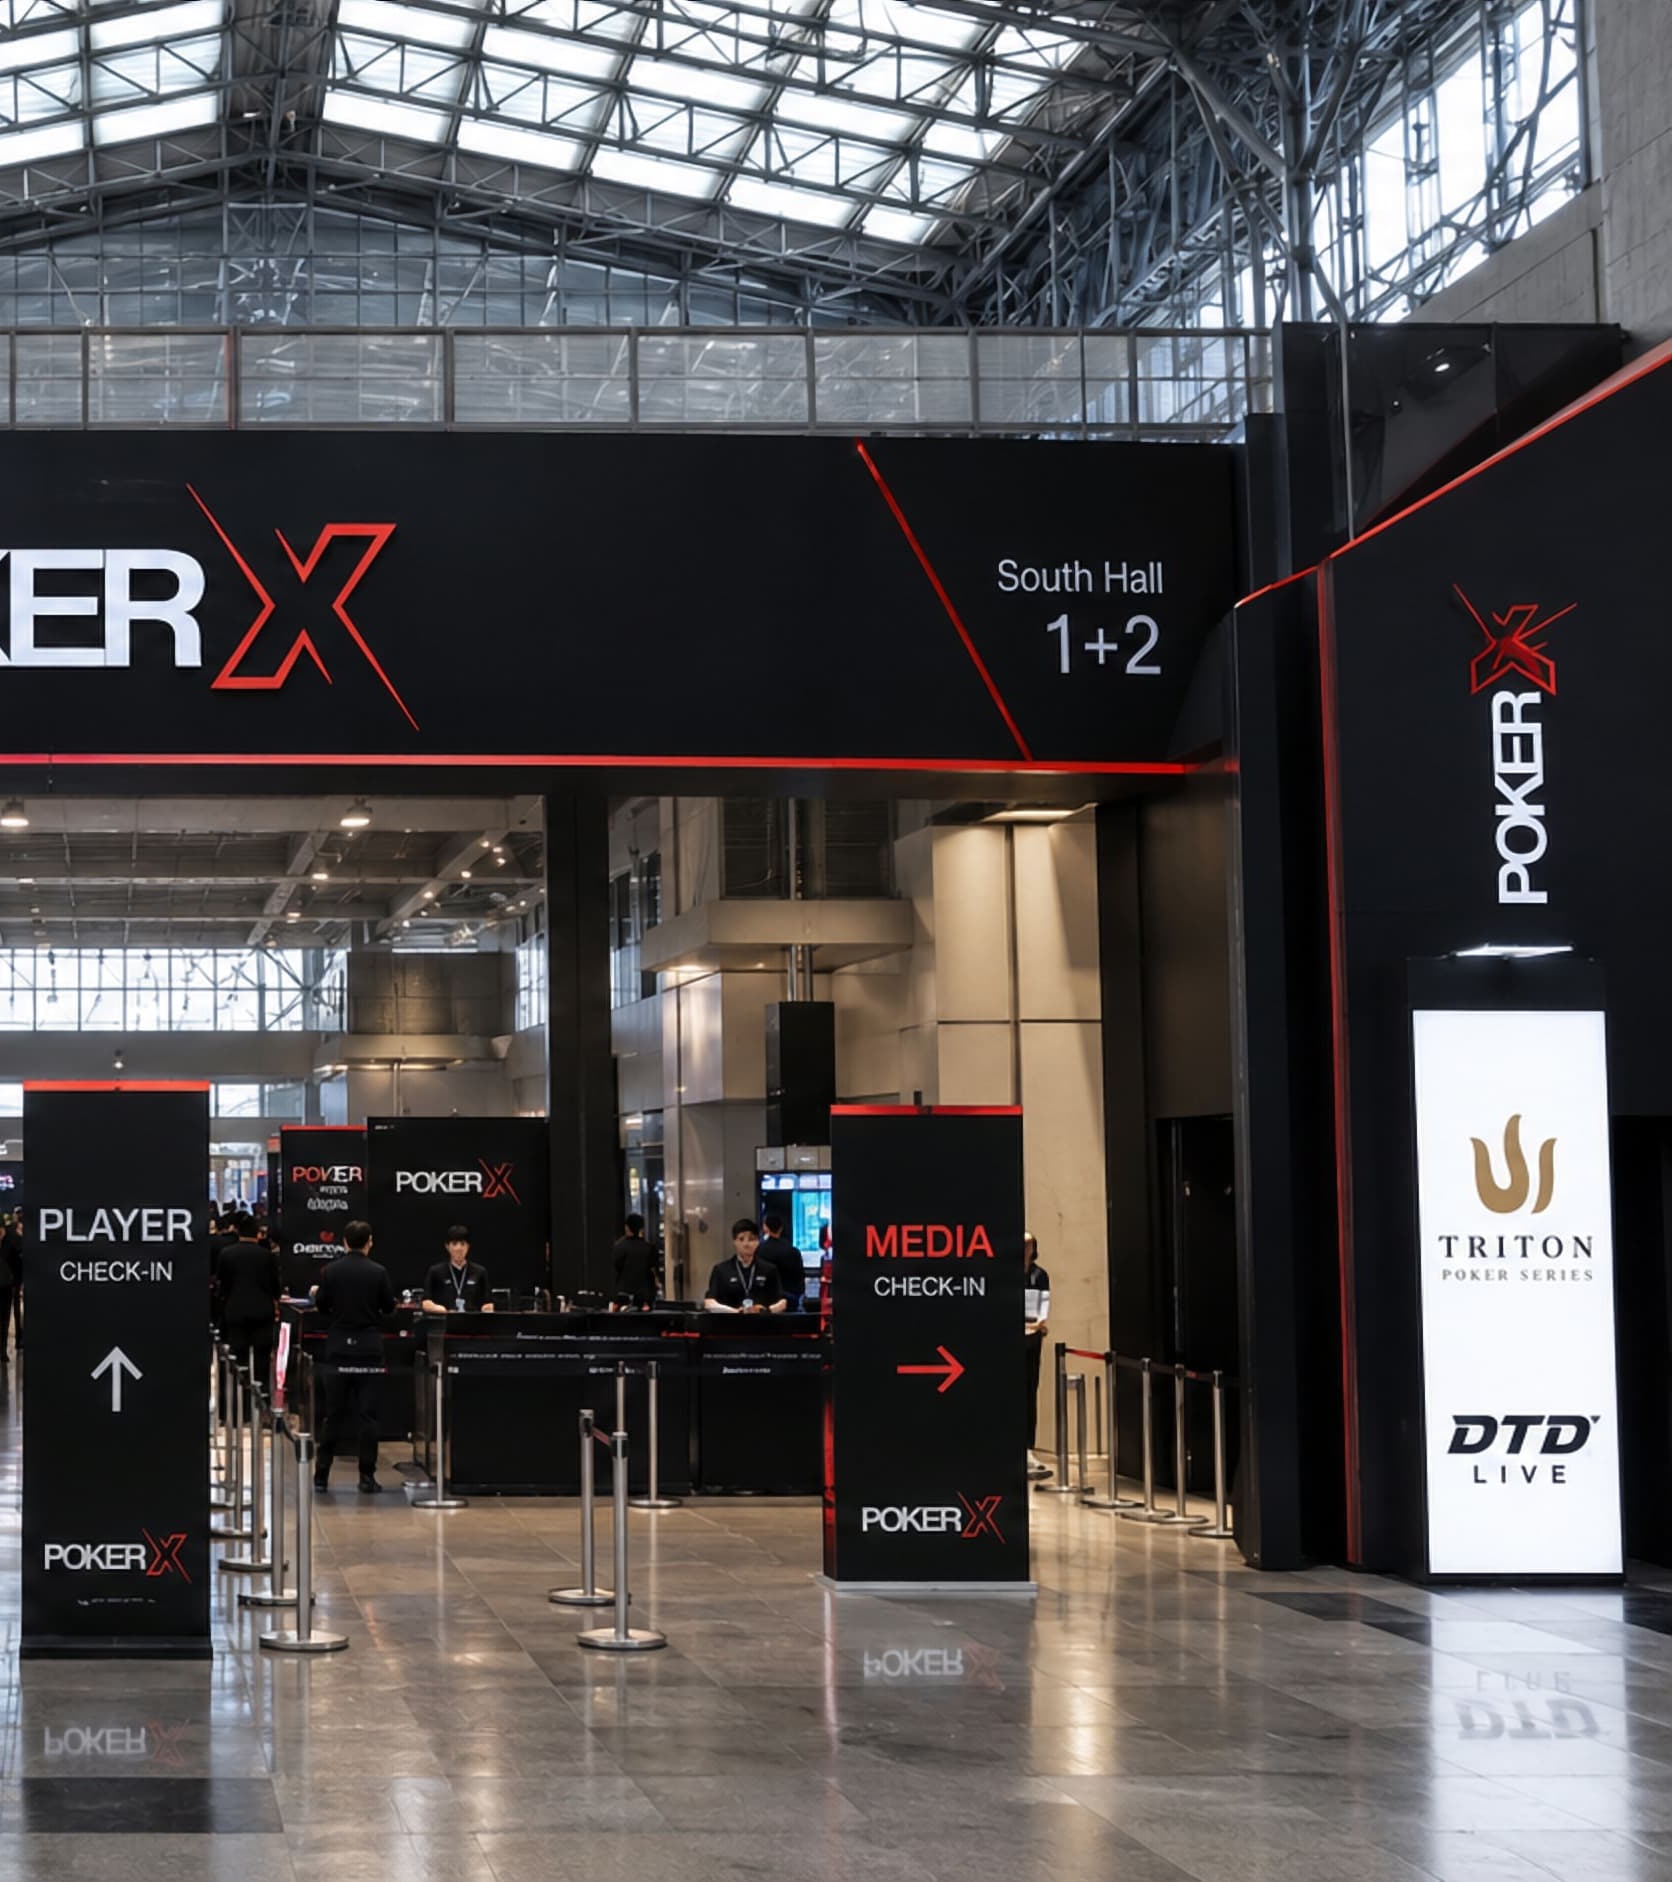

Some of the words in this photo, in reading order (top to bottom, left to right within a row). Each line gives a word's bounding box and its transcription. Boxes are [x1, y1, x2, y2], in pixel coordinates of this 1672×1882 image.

[998, 559, 1093, 593] South
[1104, 561, 1164, 594] Hall
[1047, 614, 1162, 674] 1+2
[39, 1208, 193, 1242] PLAYER
[865, 1223, 996, 1259] MEDIA
[1438, 1235, 1593, 1259] TRITON
[59, 1260, 174, 1282] CHECK-IN
[1442, 1269, 1508, 1281] POKER
[1520, 1269, 1593, 1281] SERIES
[874, 1276, 986, 1297] CHECK-IN
[1447, 1414, 1601, 1455] DTD
[1473, 1464, 1566, 1484] LIVE
